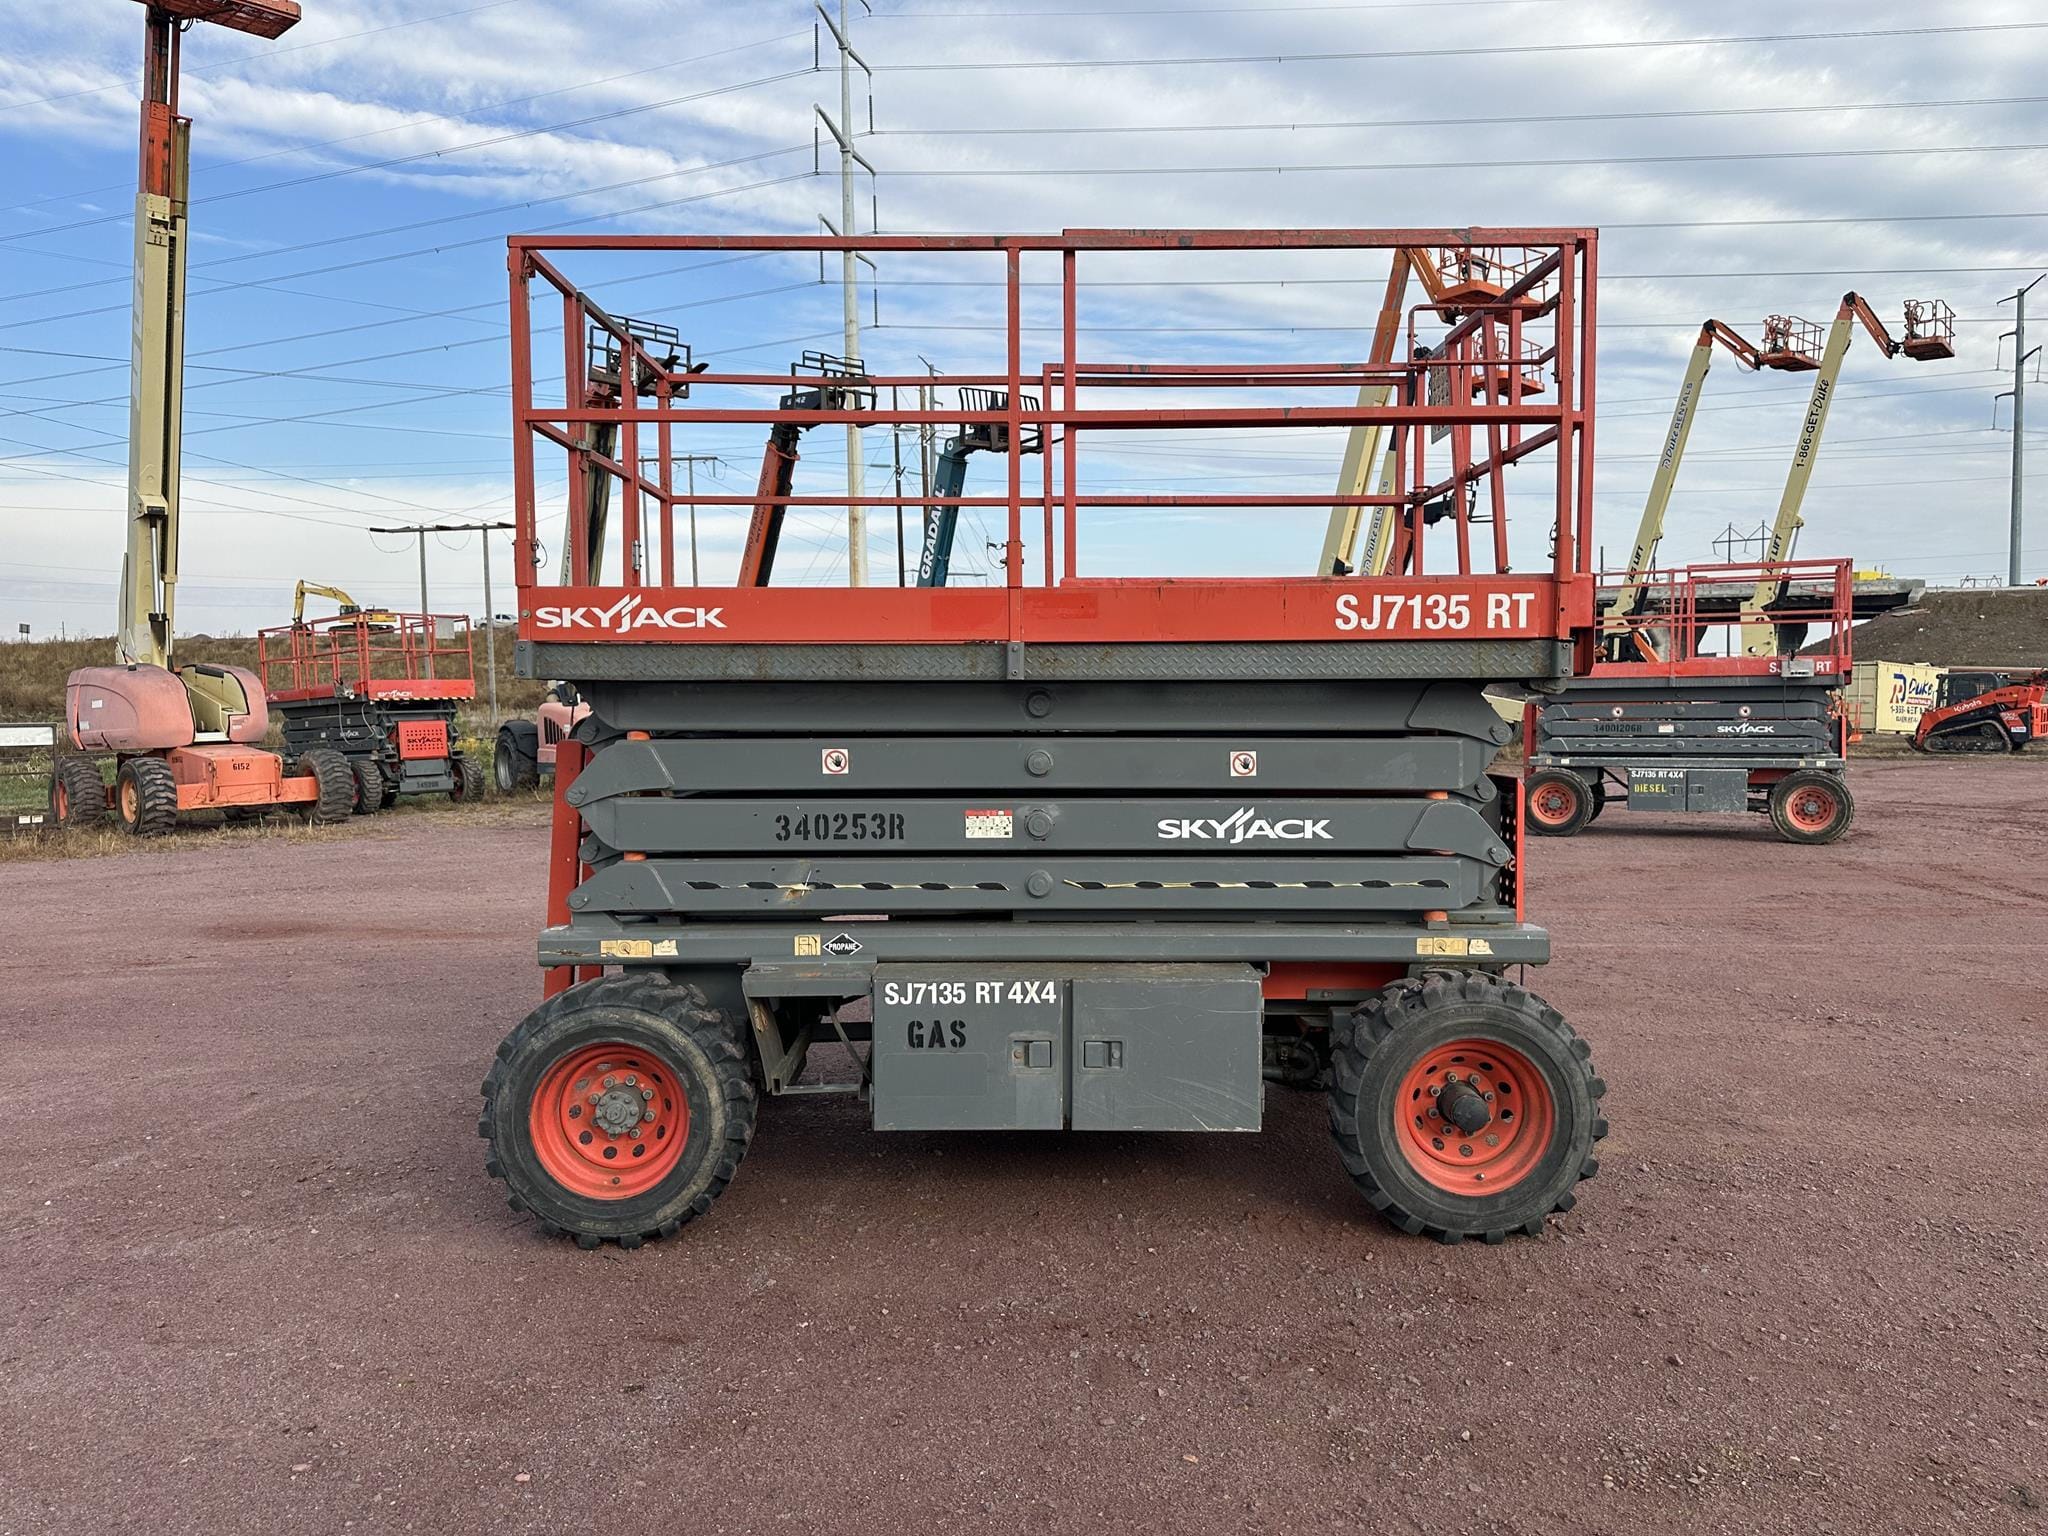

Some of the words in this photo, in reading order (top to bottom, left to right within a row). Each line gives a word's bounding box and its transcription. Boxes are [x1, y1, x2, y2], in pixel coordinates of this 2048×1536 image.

[786, 396, 807, 406] 642
[1373, 480, 1389, 530] RENLS
[1633, 544, 1644, 566] LIFT
[1771, 533, 1782, 556] LIFT
[535, 593, 728, 634] SKYJACK
[1335, 593, 1471, 630] SJ7135
[1487, 592, 1535, 629] RT
[1816, 660, 1832, 673] RT
[1717, 722, 1775, 734] SKYJACK
[407, 735, 442, 744] SKYJACK
[232, 762, 251, 771] 6152
[1658, 770, 1668, 778] RT
[1668, 770, 1684, 779] 4X4
[1634, 783, 1667, 793] DIESEL
[775, 813, 905, 841] 340253R
[1157, 806, 1334, 844] SKYJACK
[828, 942, 857, 951] PROPANE
[885, 982, 966, 1005] SJ7135
[976, 981, 1004, 1004] RT
[1007, 981, 1057, 1004] 4X4
[907, 1020, 967, 1049] GAS
